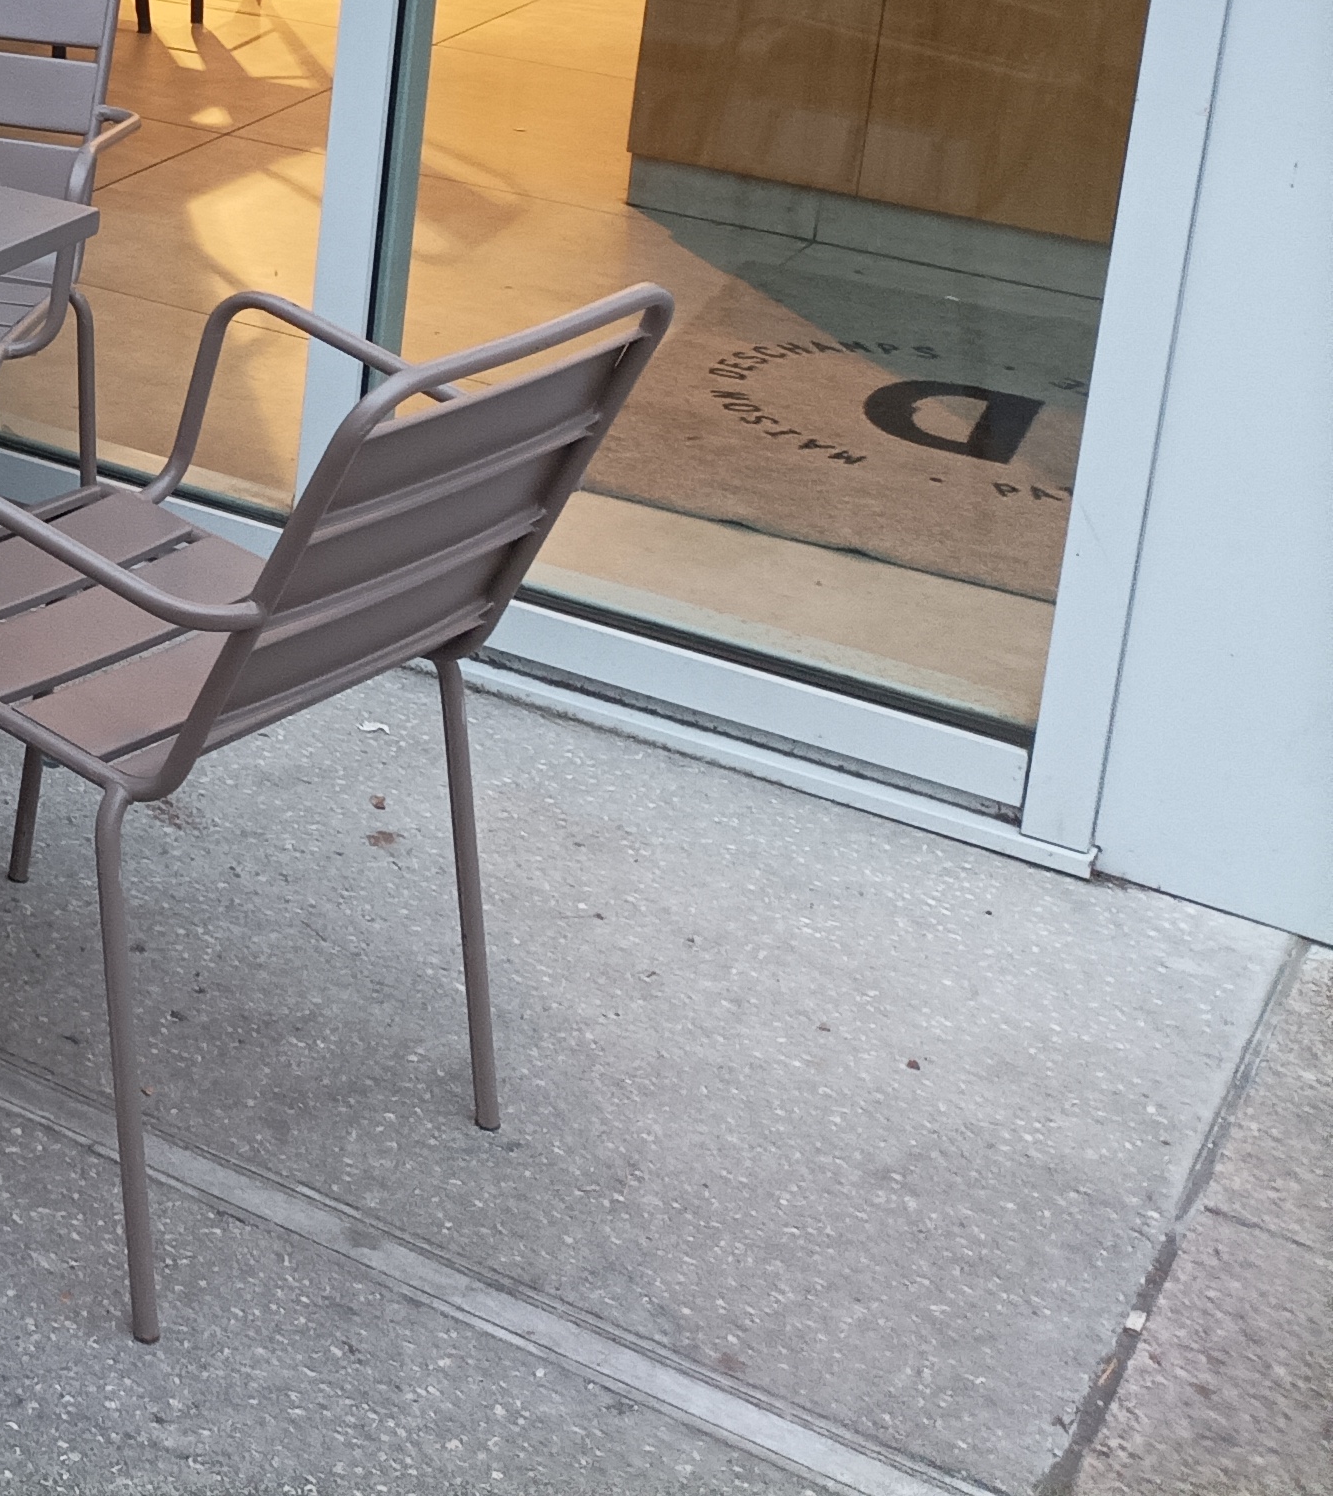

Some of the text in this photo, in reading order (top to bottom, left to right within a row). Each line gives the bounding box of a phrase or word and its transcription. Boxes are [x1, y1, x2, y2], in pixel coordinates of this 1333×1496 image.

[707, 339, 939, 465] MAISON DESCHAMPS
[863, 379, 1047, 465] D
